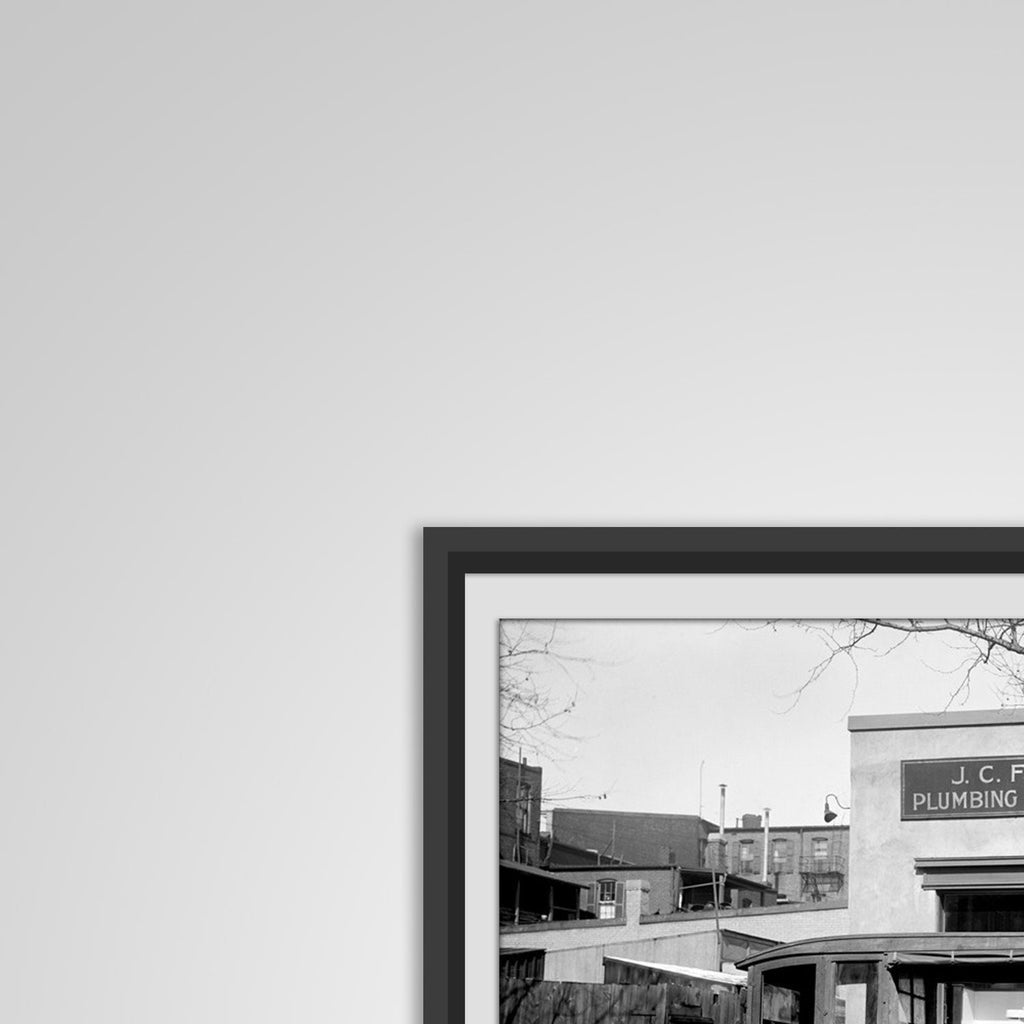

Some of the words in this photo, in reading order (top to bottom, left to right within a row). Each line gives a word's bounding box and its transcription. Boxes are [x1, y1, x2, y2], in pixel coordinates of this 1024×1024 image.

[951, 766, 969, 785] J.
[979, 765, 1001, 784] C.
[912, 789, 1018, 811] PLUMBING
